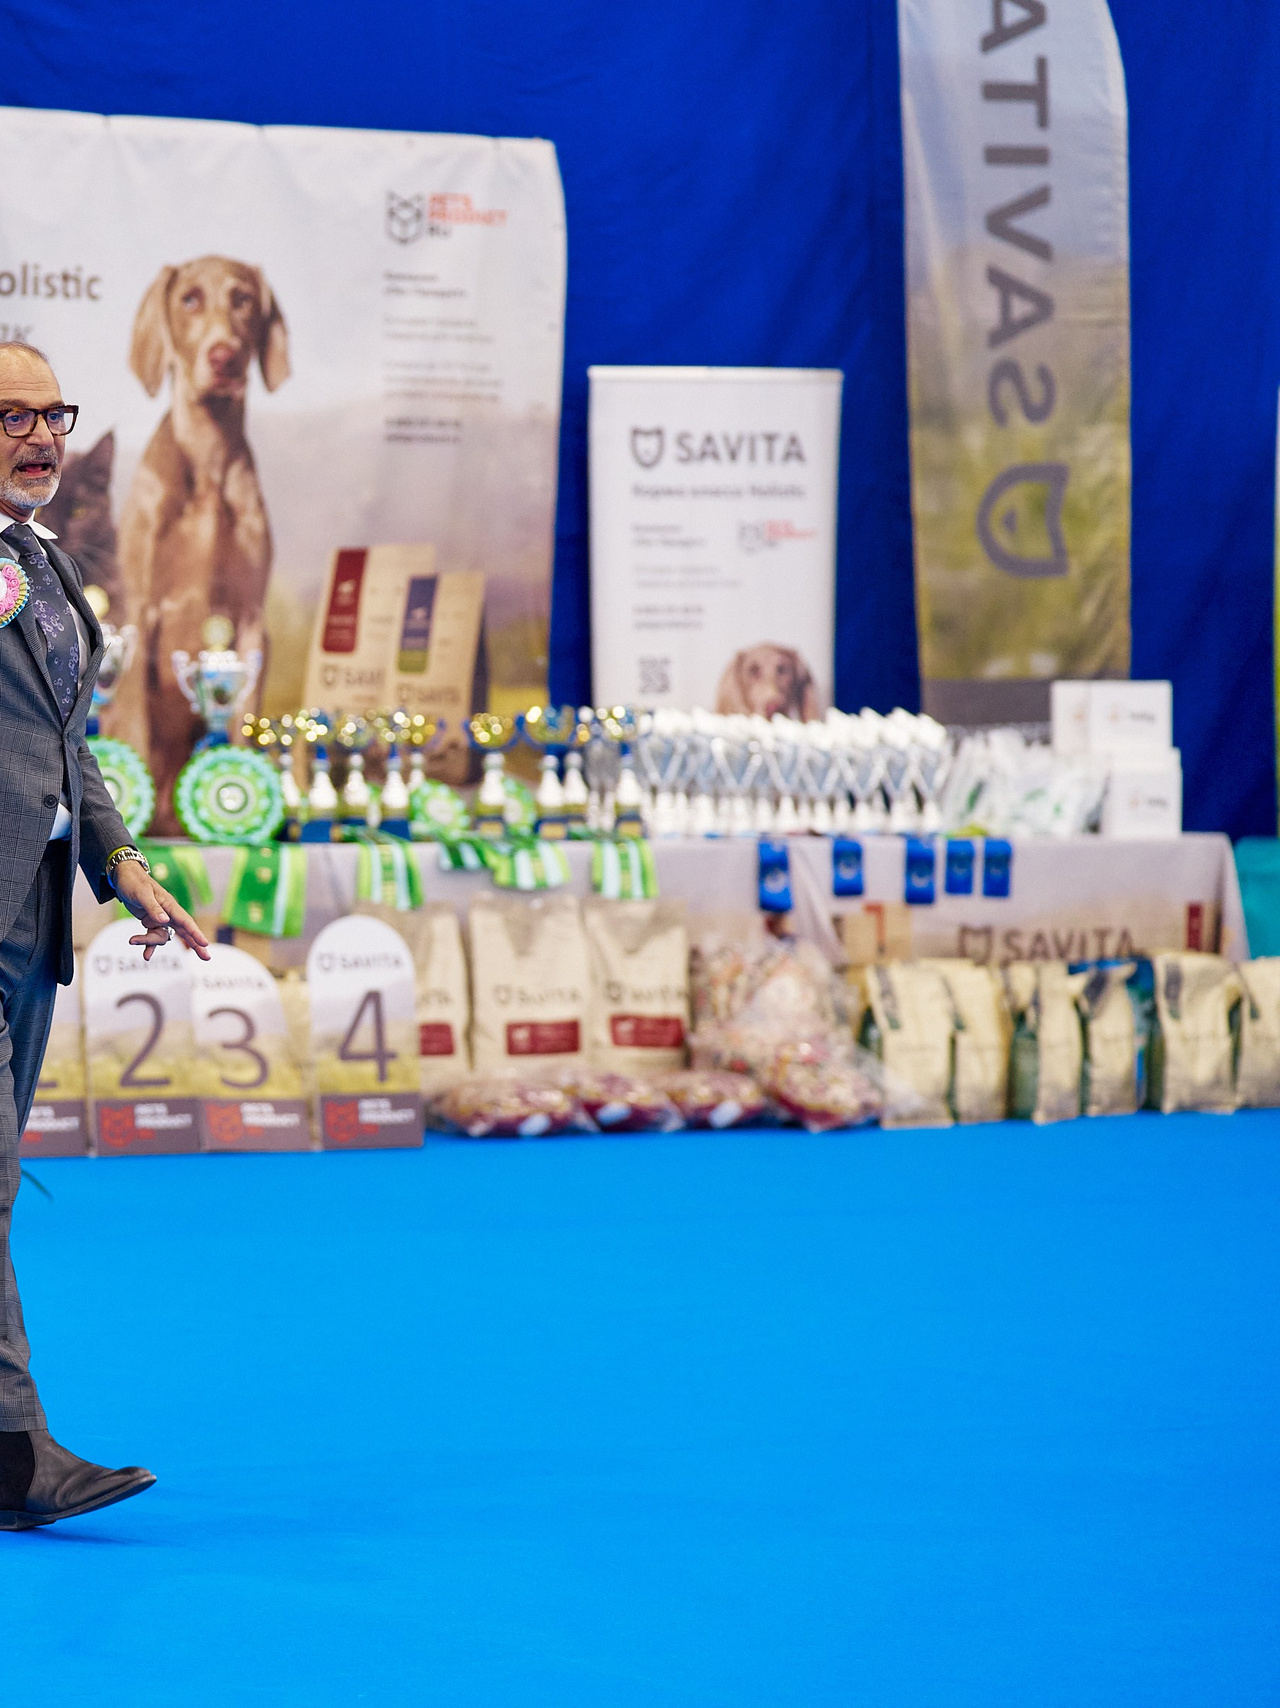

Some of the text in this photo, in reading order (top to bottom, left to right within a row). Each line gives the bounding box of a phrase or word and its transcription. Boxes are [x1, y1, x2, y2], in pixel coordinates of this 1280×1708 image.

[675, 431, 807, 465] SAVITA
[116, 992, 171, 1088] 2
[207, 1007, 271, 1090] 3
[339, 990, 398, 1083] 4
